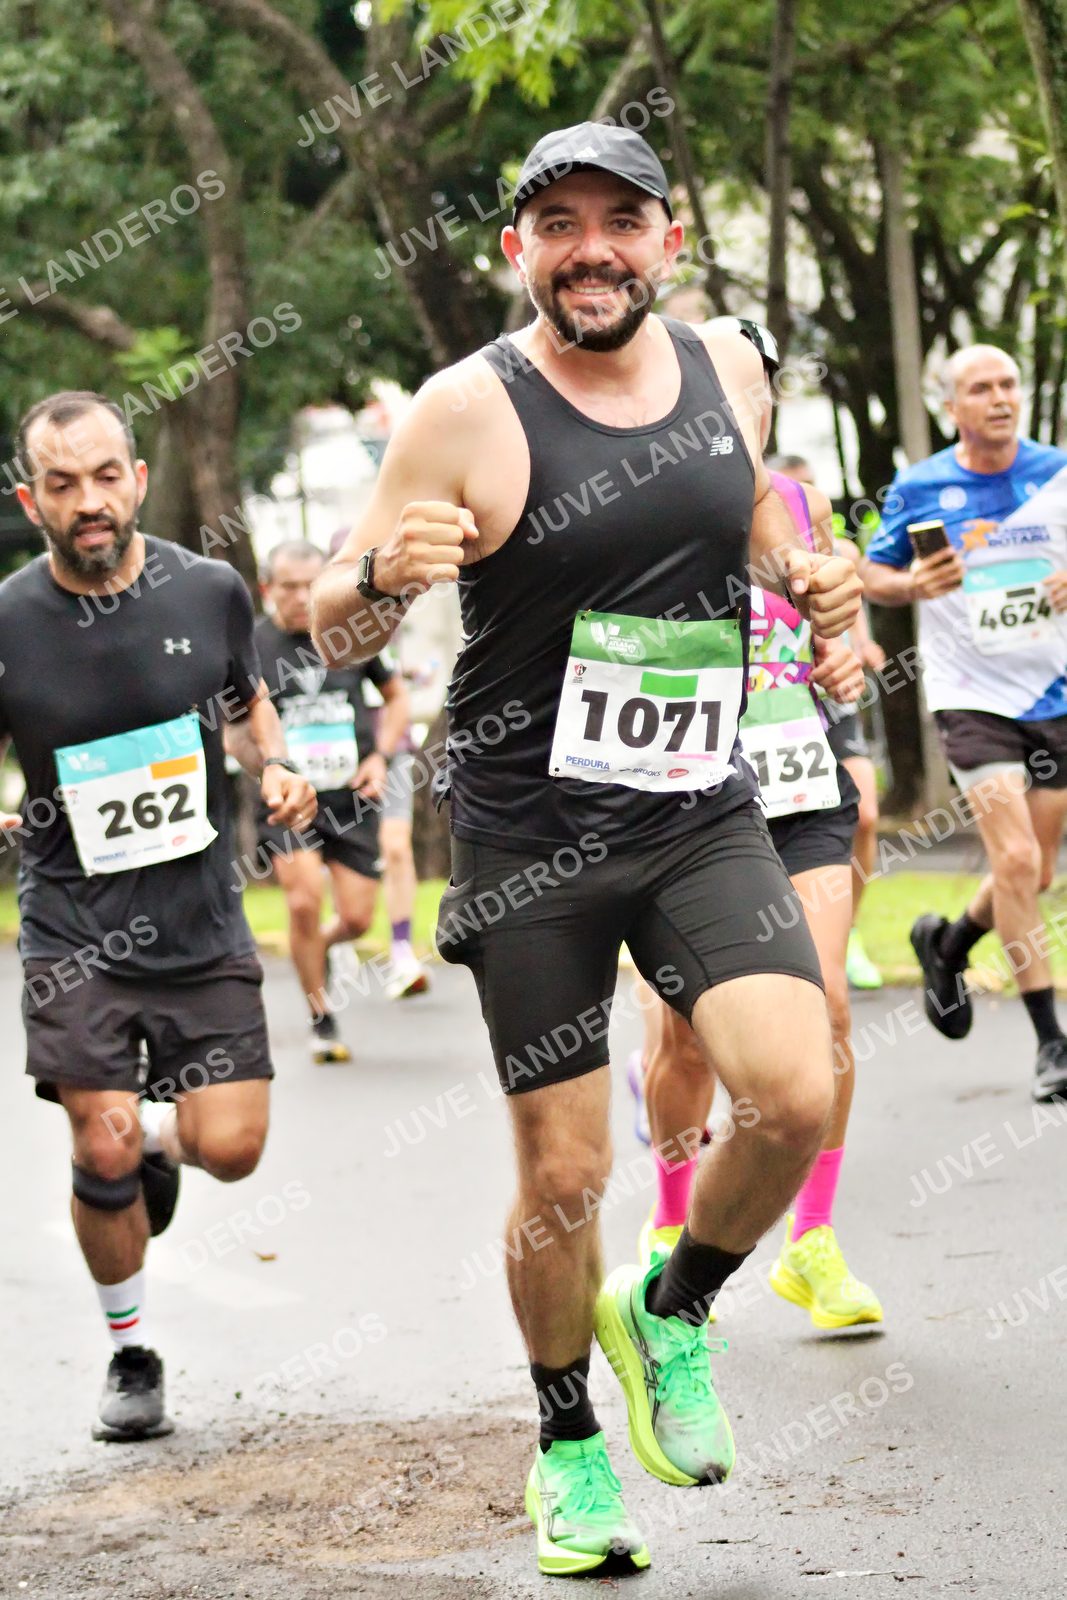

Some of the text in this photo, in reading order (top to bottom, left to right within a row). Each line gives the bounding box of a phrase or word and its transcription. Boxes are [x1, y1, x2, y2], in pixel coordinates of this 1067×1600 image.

[580, 689, 722, 753] 1071
[565, 755, 611, 771] PERDURA
[97, 783, 197, 840] 262
